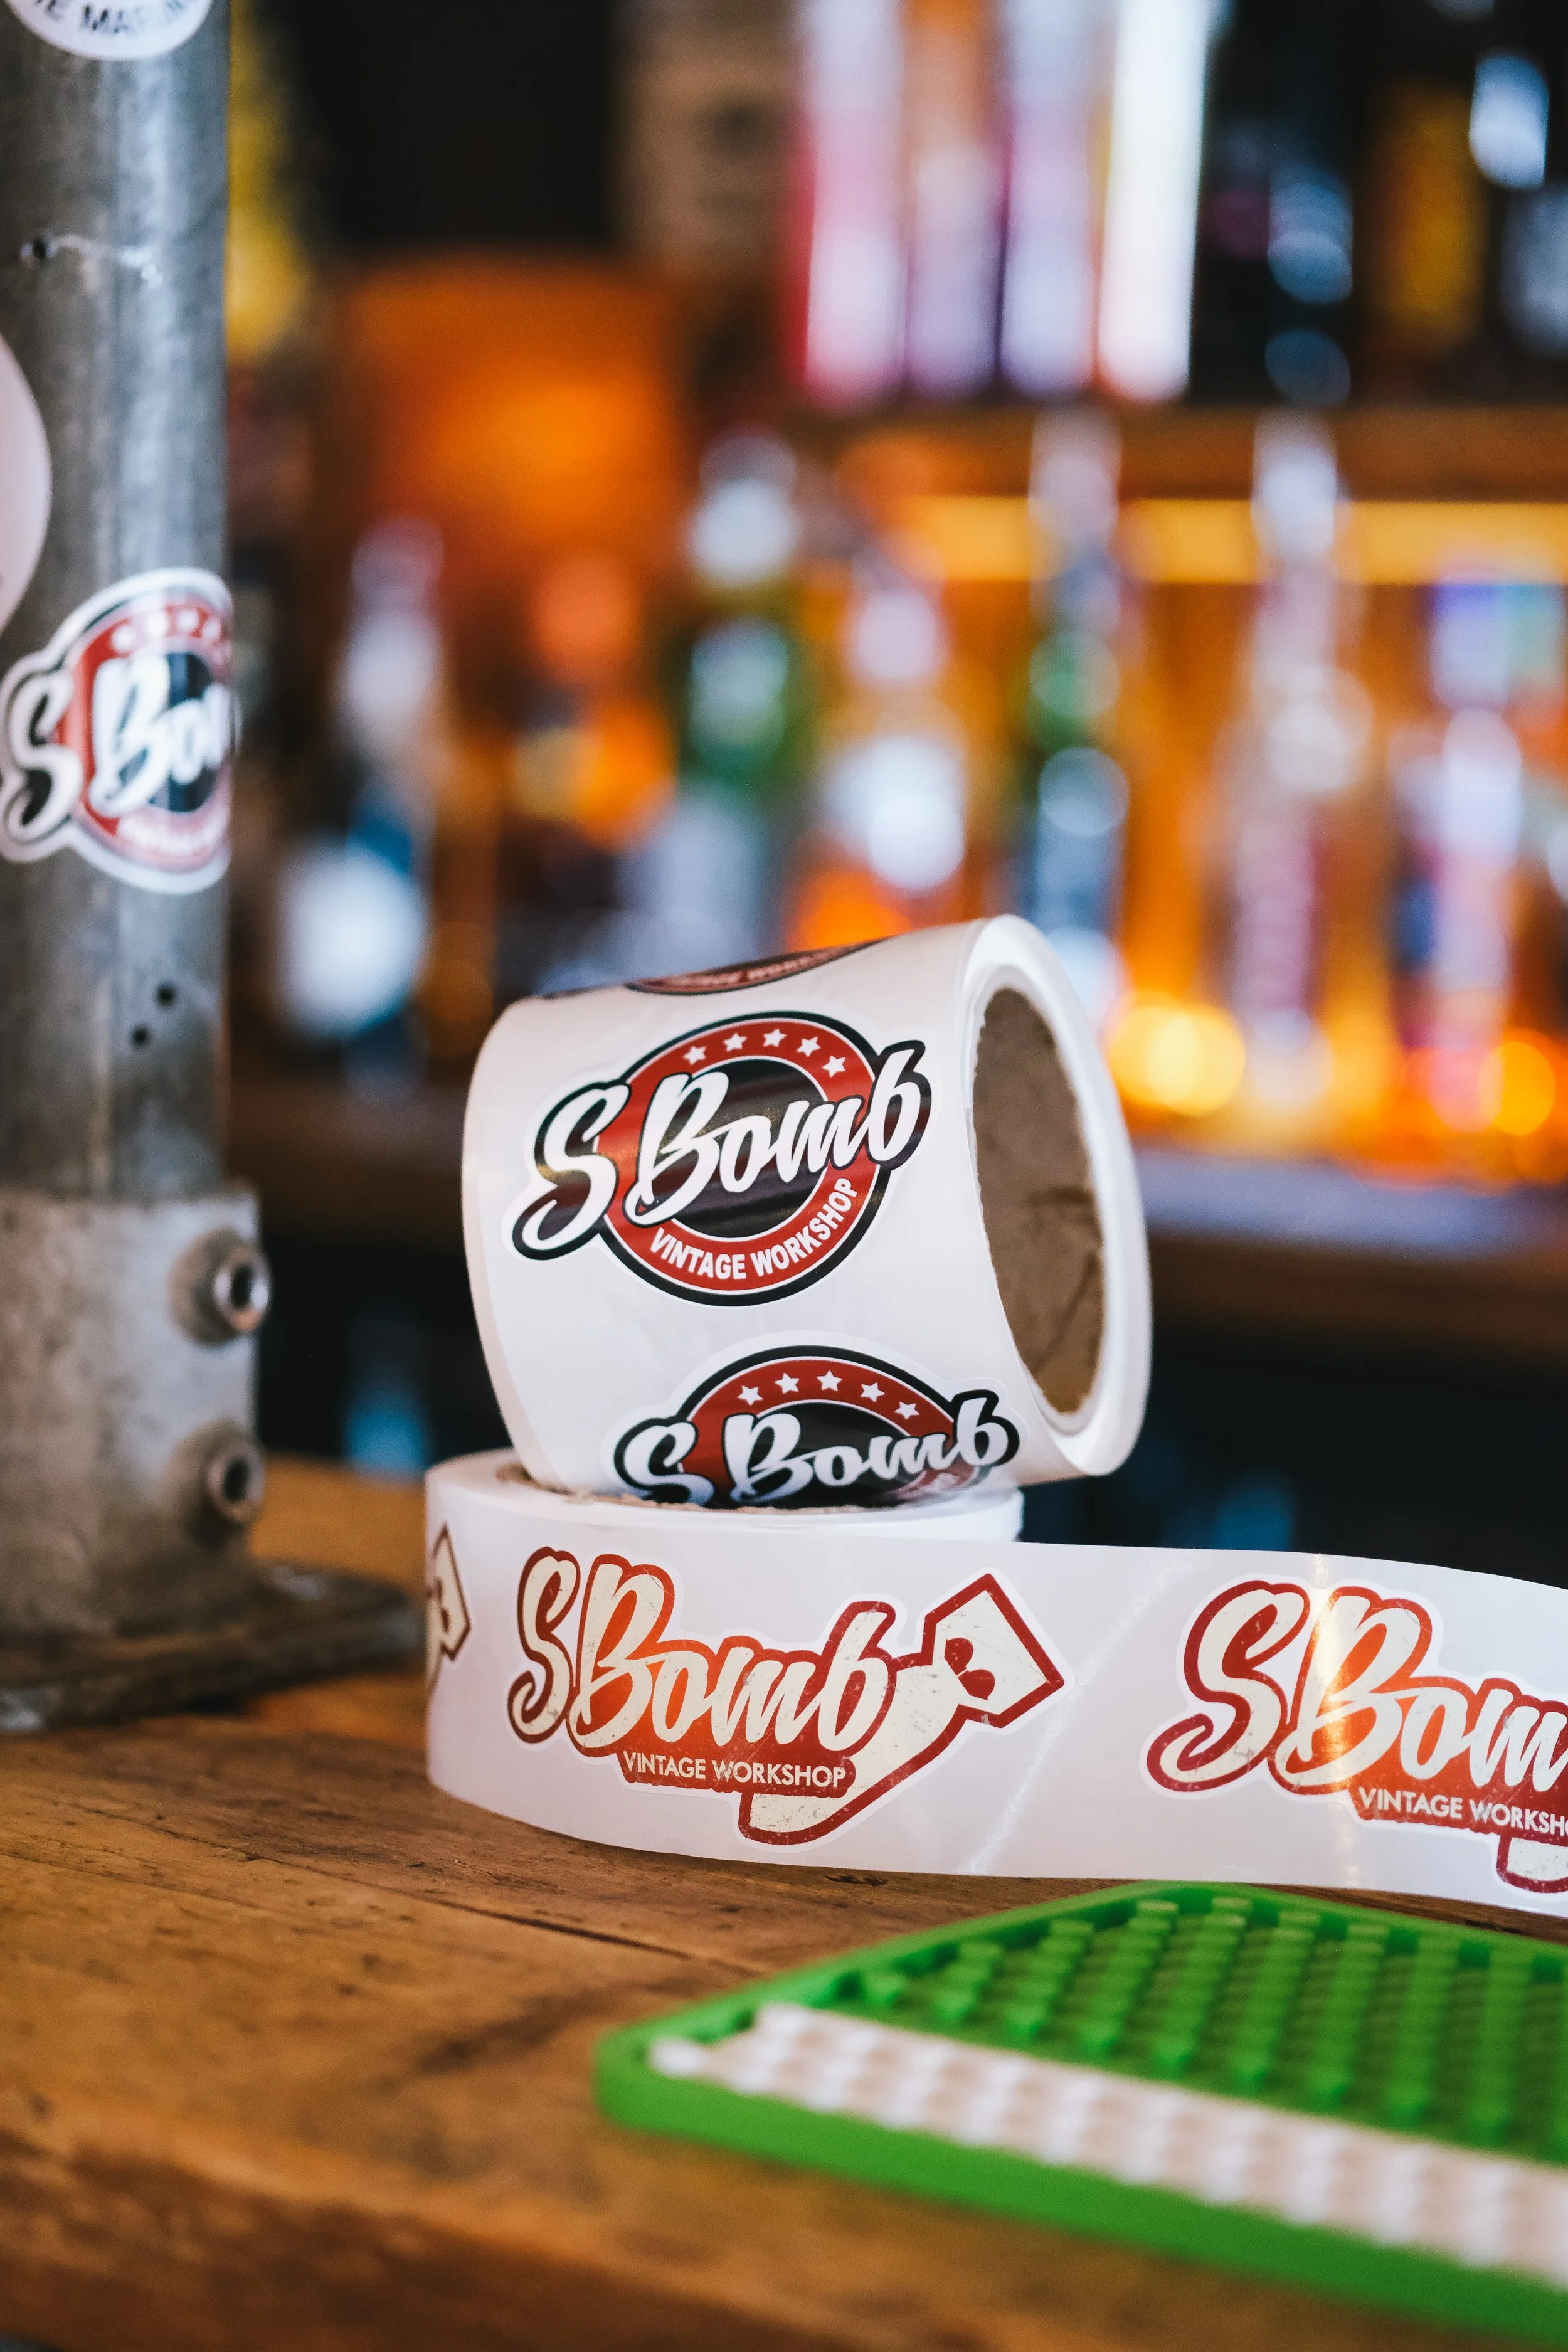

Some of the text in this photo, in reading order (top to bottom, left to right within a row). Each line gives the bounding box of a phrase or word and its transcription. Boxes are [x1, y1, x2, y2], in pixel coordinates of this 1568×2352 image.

[8, 671, 80, 838] S
[521, 1048, 926, 1250] S Bomb
[649, 1177, 858, 1280] VINTAGE WORKSHOP
[626, 1397, 1009, 1506] S Bomb
[623, 1751, 847, 1788] VINTAGE WORKSHOP
[1358, 1786, 1568, 1838] VINTAGE WORKSH
